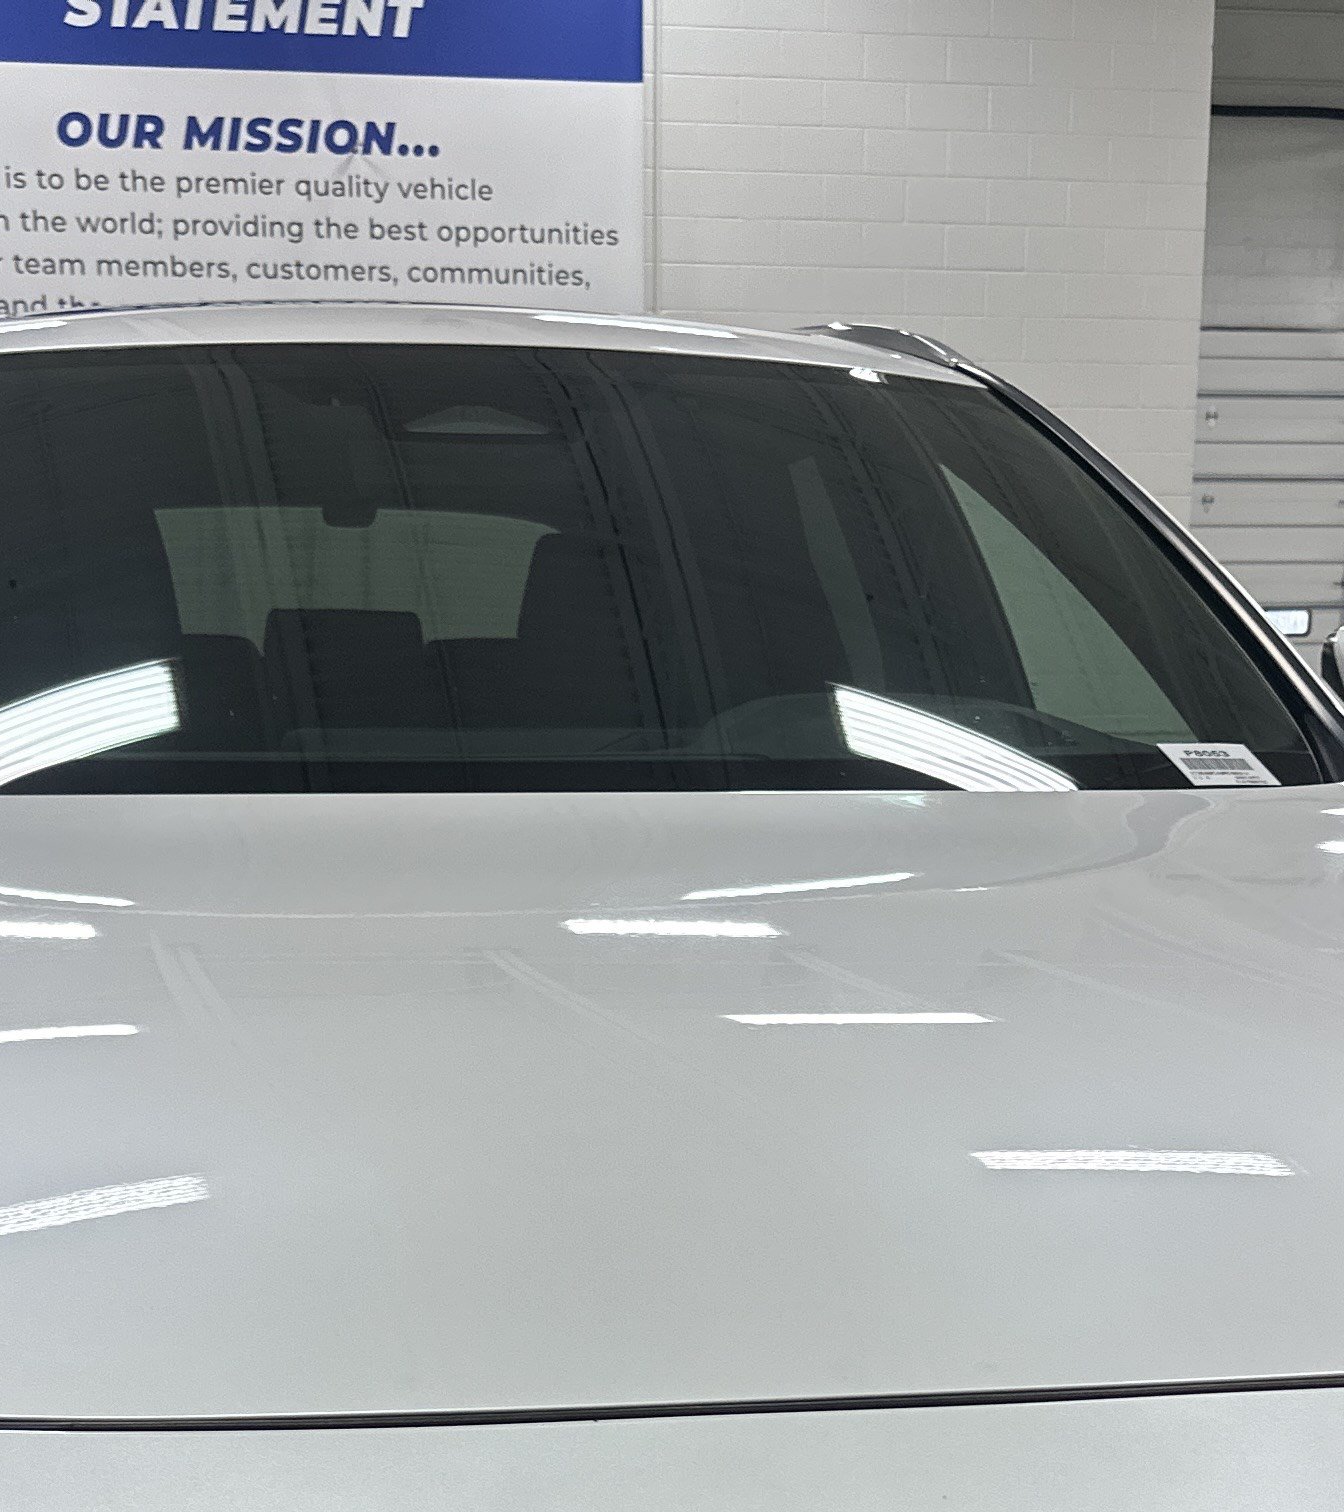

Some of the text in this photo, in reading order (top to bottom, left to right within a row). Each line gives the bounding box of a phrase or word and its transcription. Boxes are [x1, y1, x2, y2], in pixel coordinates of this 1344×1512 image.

[63, 0, 425, 38] STATEMENT
[56, 111, 440, 158] OUR MISSION...
[4, 166, 494, 204] is to be the premier quality vehicle
[19, 209, 67, 233] the
[75, 211, 164, 239] world;
[172, 213, 305, 244] providing
[312, 216, 359, 240] the
[369, 217, 429, 242] best
[437, 220, 619, 249] opportunities
[13, 254, 86, 276] team
[96, 255, 238, 283] members,
[246, 260, 399, 287] customers,
[407, 262, 592, 290] communities,
[57, 294, 100, 308] th
